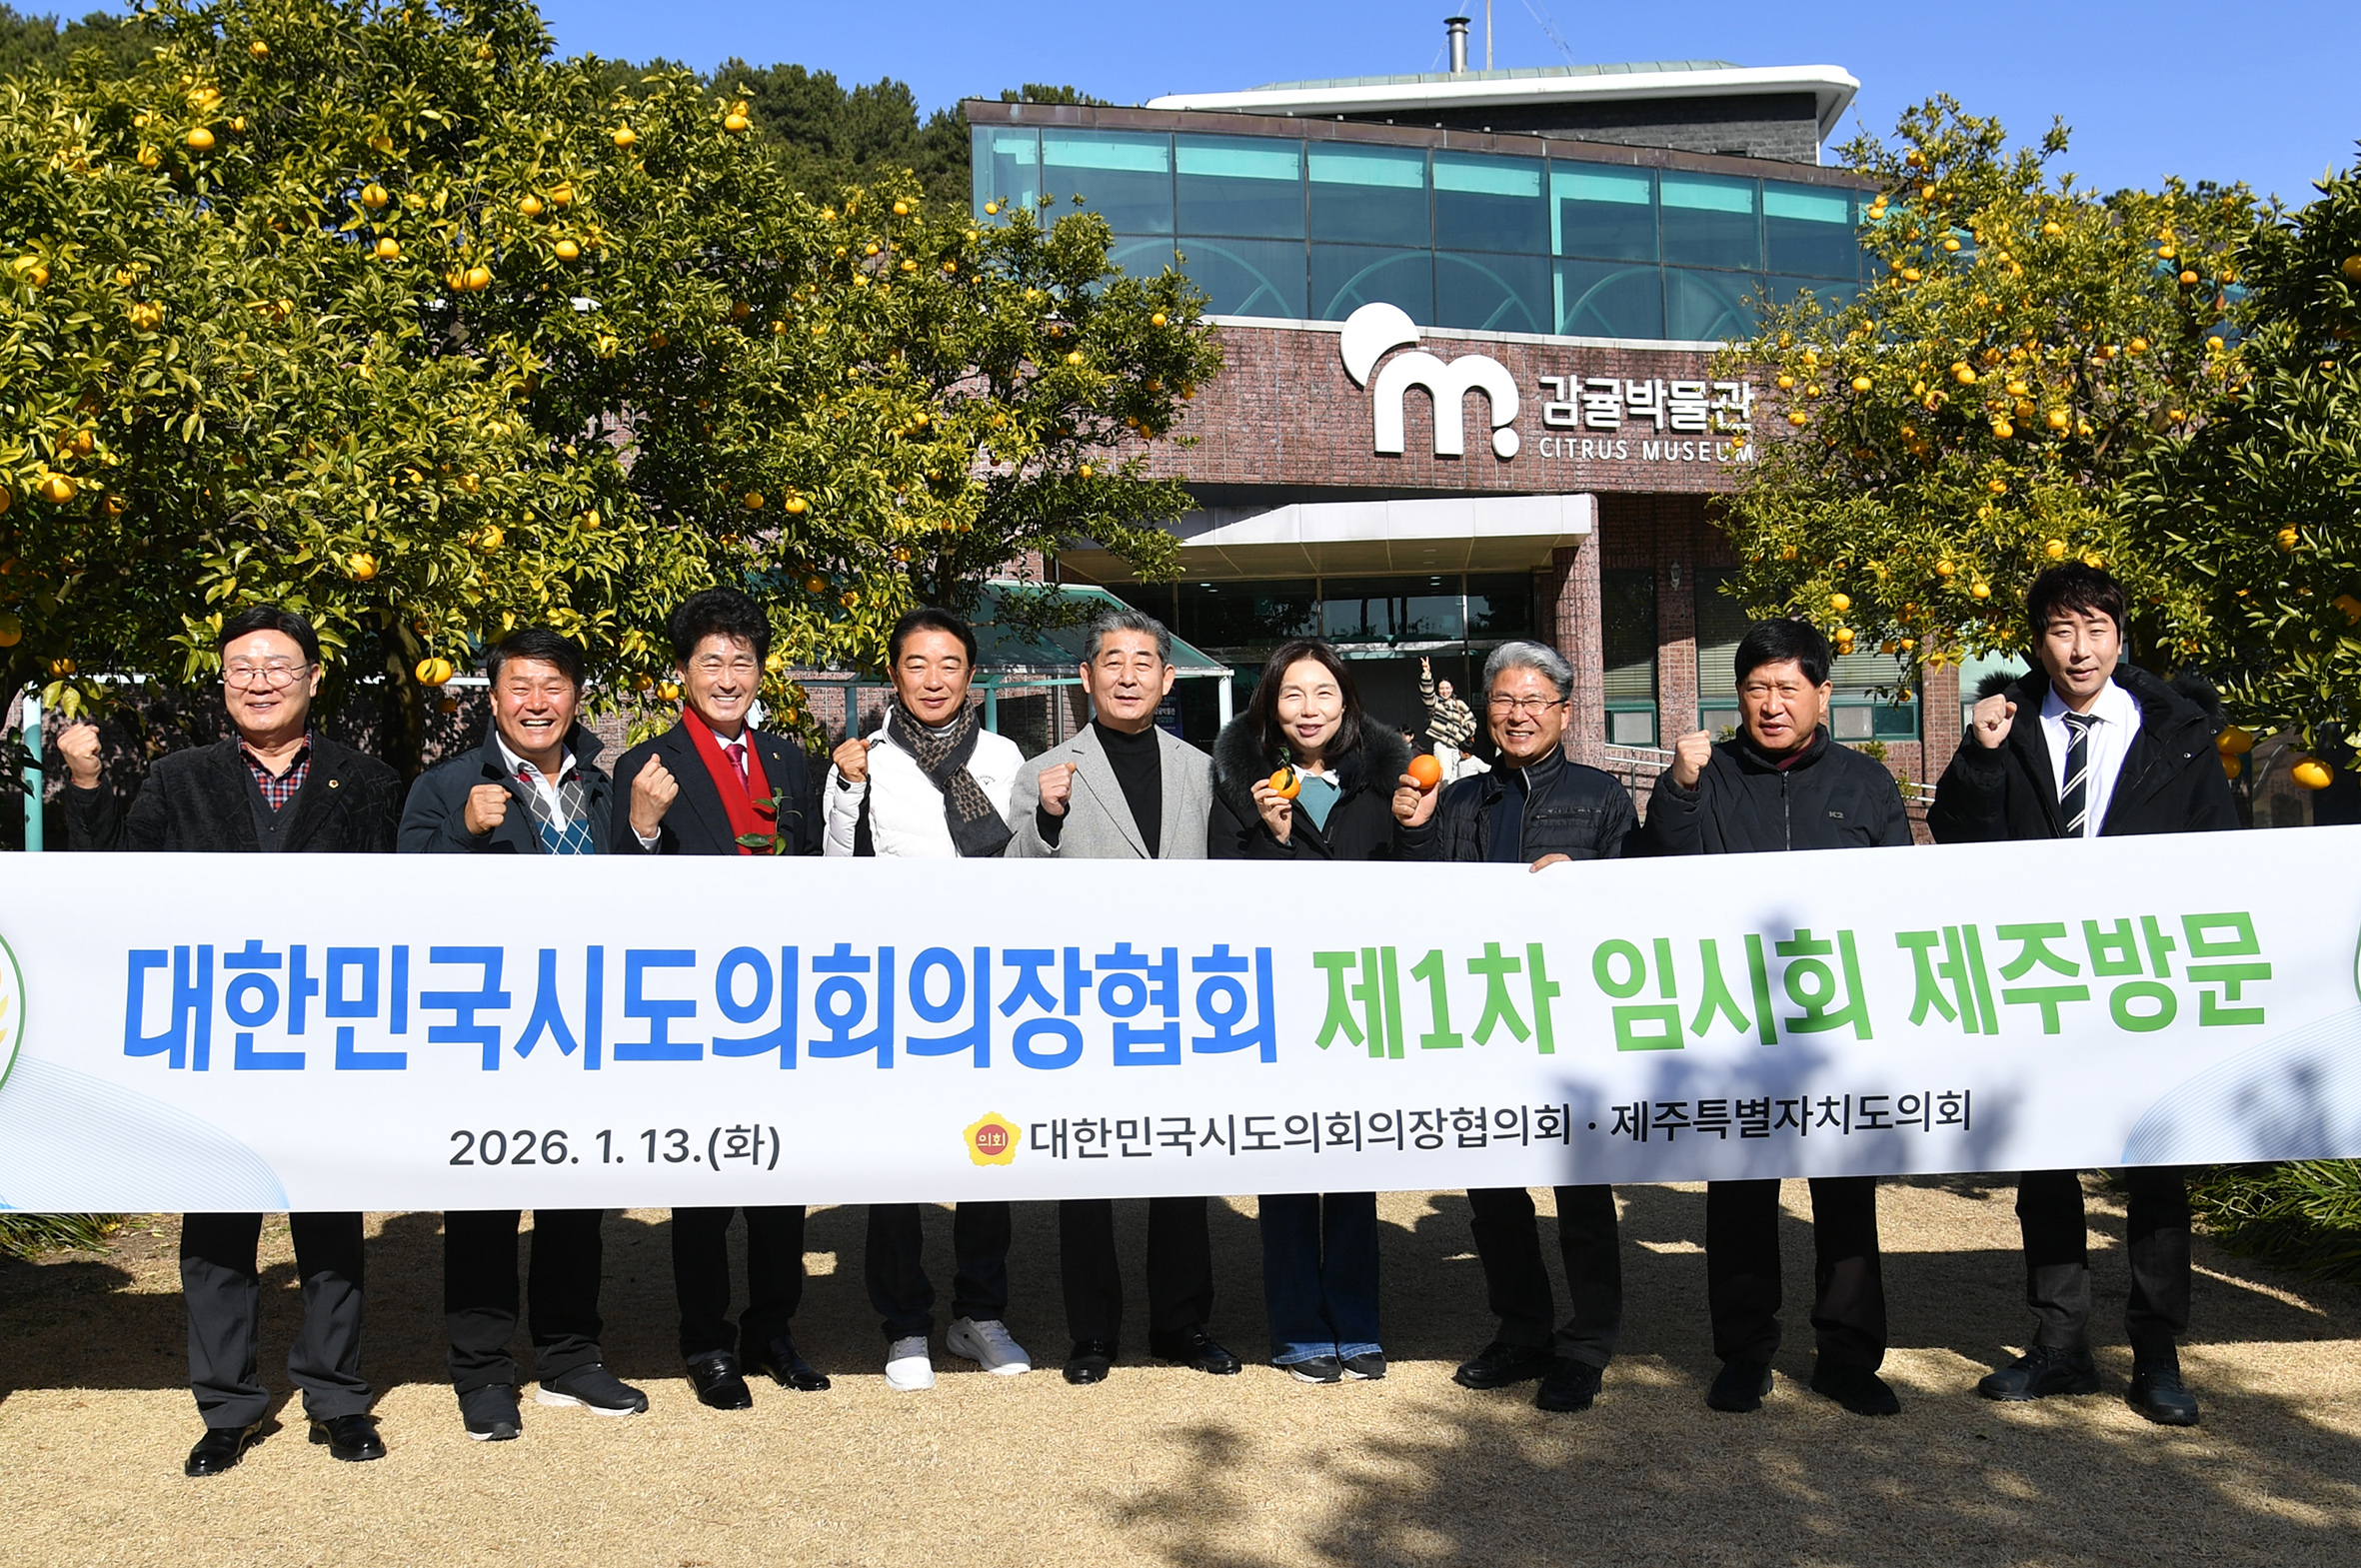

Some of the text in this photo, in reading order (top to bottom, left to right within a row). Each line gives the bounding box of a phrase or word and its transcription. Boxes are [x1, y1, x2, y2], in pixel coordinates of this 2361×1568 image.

[1539, 374, 1755, 431] 감귤박물관
[1539, 437, 1754, 464] CITRUS MUSEUM
[1828, 810, 1844, 819] K2
[123, 911, 2272, 1072] 대한민국시도의회의장협회 제1차 임시회 제주방문
[449, 1123, 781, 1172] 2026. 1. 13.(화)
[977, 1132, 1006, 1147] 의회
[1031, 1102, 1571, 1160] 대한민국시도의회의장협의회
[1610, 1089, 1971, 1143] 제주특별자치도의회
